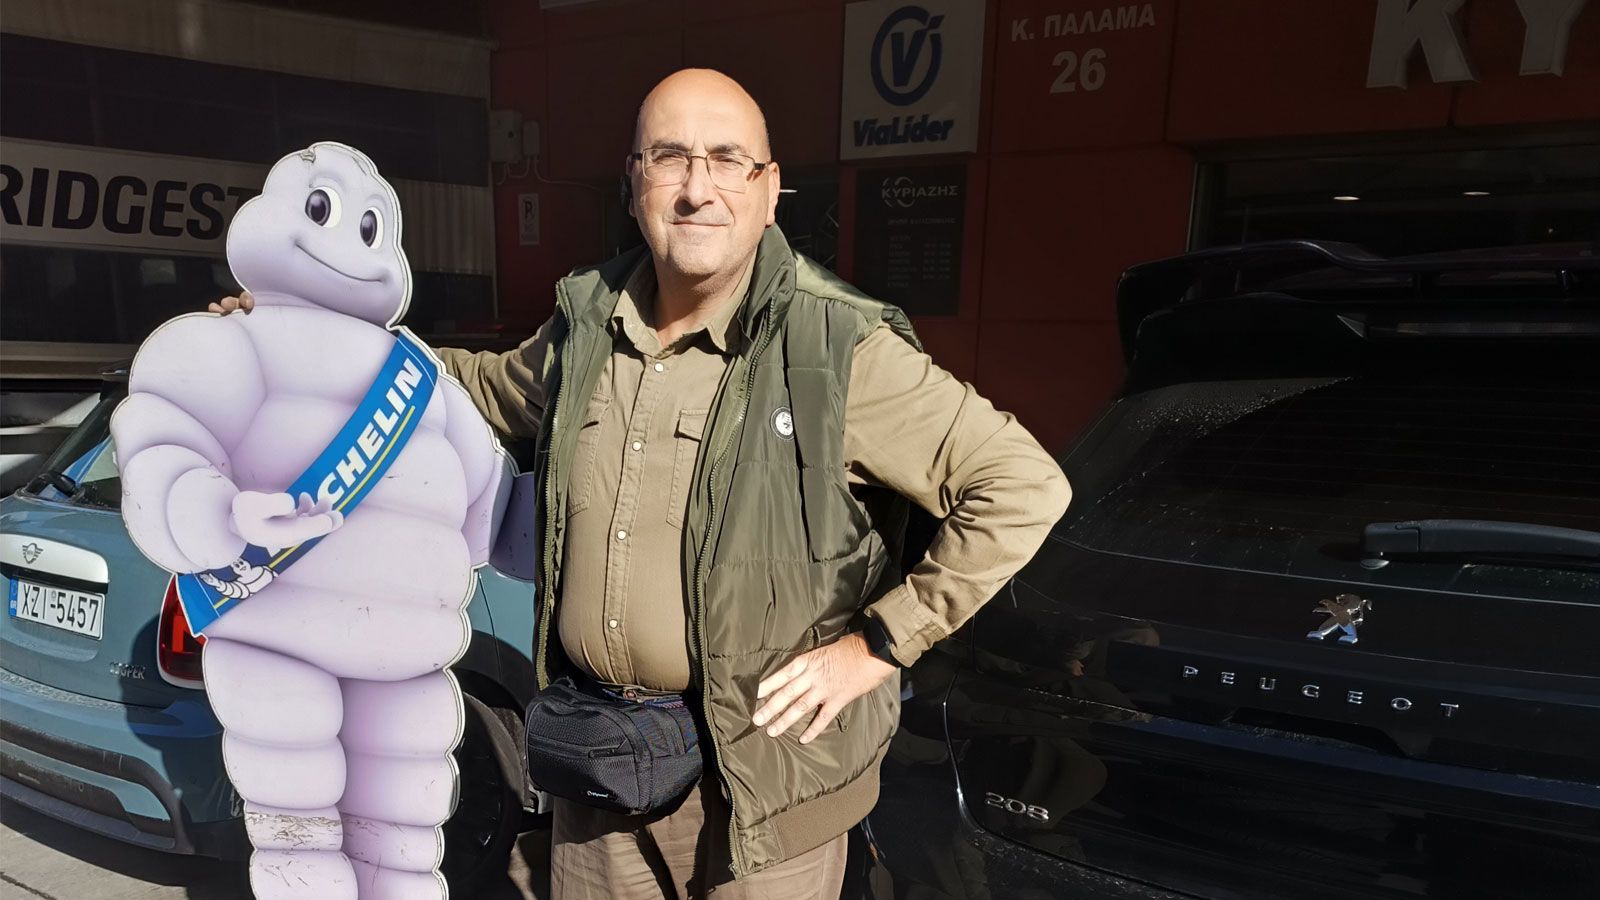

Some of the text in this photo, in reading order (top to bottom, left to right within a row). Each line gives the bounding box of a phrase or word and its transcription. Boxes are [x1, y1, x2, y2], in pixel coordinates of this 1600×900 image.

[1043, 4, 1157, 38] ΠΑΛΑΜΑ
[1049, 47, 1107, 94] 26
[881, 185, 960, 200] ΚΥΡΙΑΖΗΣ
[1182, 664, 1460, 719] PEUGEOT
[984, 791, 1052, 823] 208
